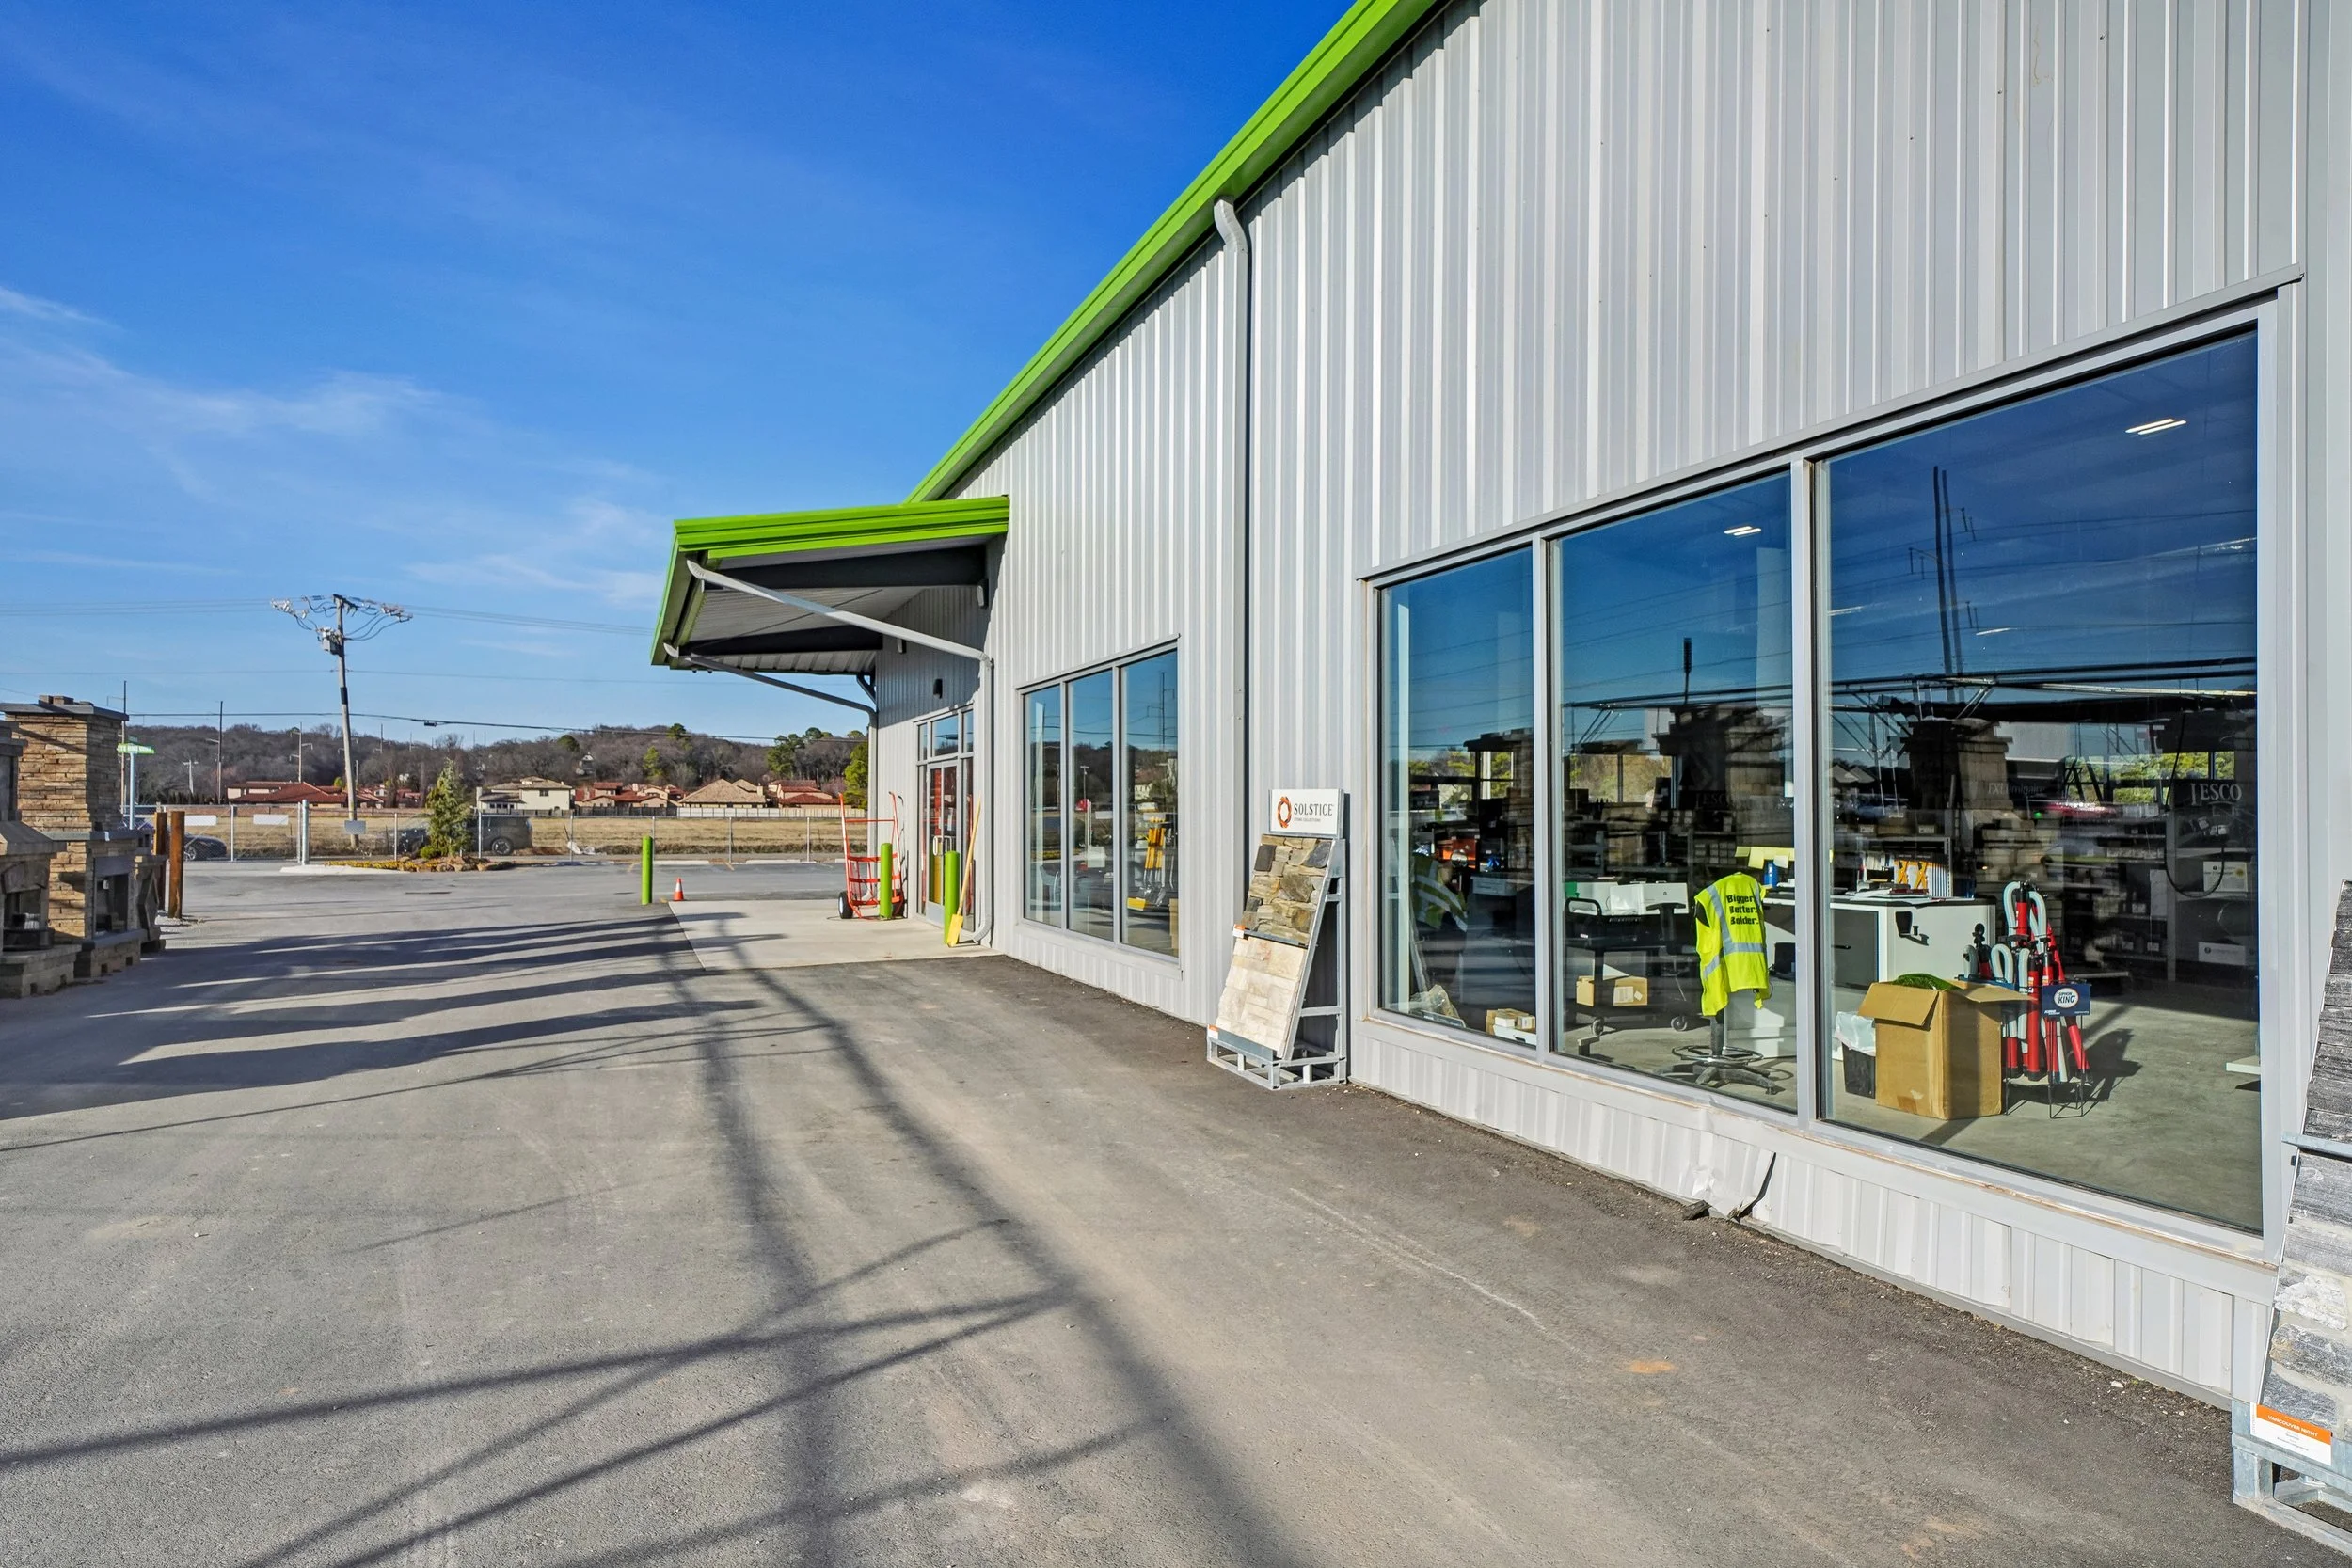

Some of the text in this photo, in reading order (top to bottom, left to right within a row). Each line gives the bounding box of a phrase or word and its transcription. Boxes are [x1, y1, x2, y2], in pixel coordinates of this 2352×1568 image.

[1294, 803, 1333, 816] SOLSTICE
[1731, 916, 1759, 925] Bolder.
[2058, 995, 2075, 1004] KING
[2267, 1415, 2301, 1432] VANCOUVER
[2301, 1427, 2318, 1437] NIGHT
